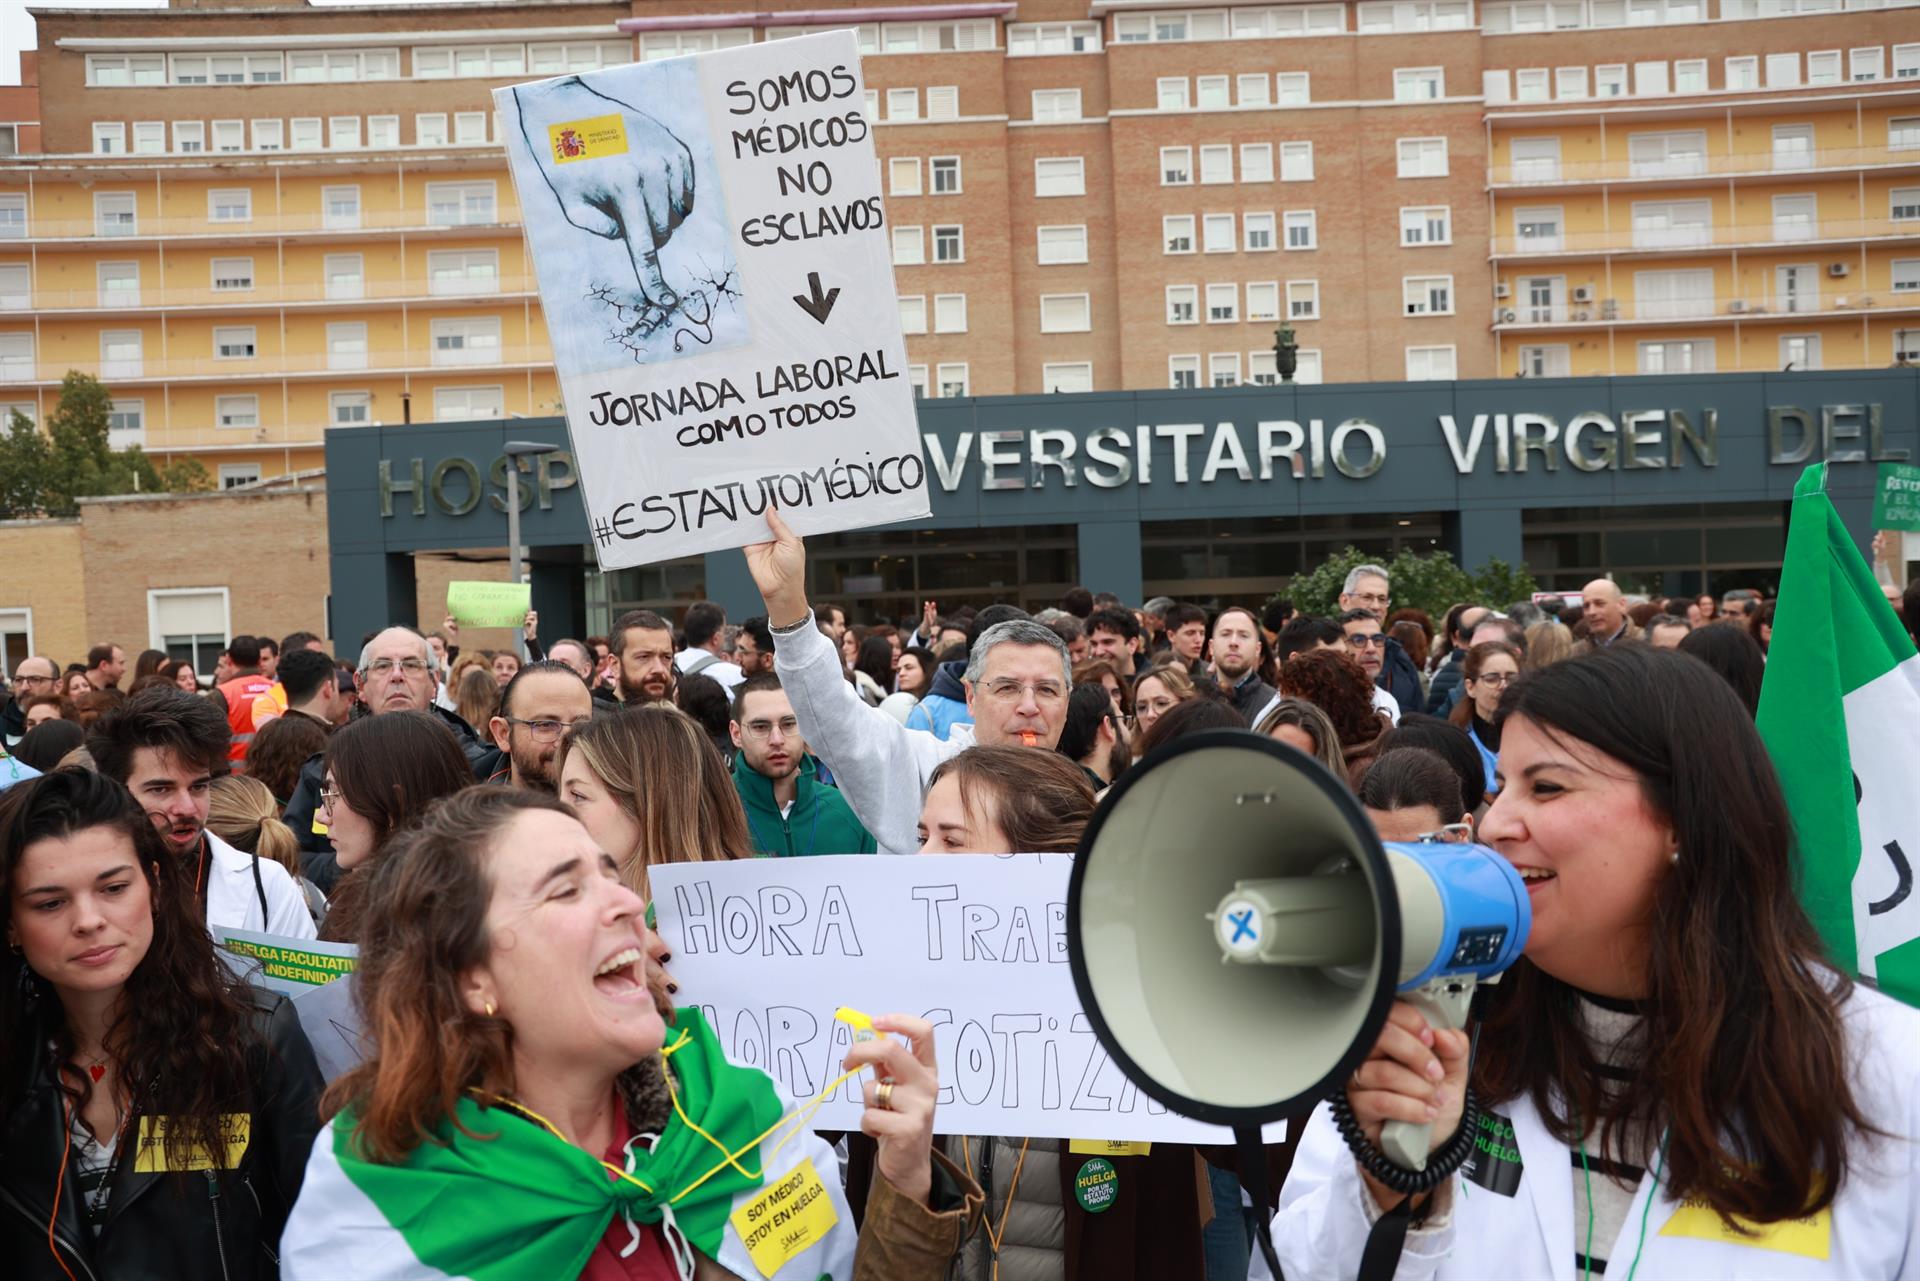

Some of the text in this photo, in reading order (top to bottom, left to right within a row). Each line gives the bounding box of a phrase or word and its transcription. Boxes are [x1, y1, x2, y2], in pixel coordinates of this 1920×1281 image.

[726, 65, 856, 115] SOMOS
[731, 111, 867, 160] MÉDICOS
[777, 161, 832, 196] NO
[741, 196, 883, 247] ESCLAVOS
[589, 350, 899, 426] JORNADA LABORAL
[676, 395, 856, 447] COMO TODOS
[378, 402, 1911, 518] HOSP VERSITARIO VIRGEN DEL
[674, 881, 1070, 964] HORA TRAB
[228, 940, 360, 972] HUELGA FACULTATIV
[265, 963, 338, 985] INDEFINIDA
[747, 1172, 805, 1223] SOY MÉDICO
[1078, 1169, 1117, 1188] HUELGA
[1084, 1186, 1114, 1201] ESTATUTO
[1088, 1182, 1110, 1194] POR UN
[1088, 1194, 1111, 1205] PROPIO
[744, 1220, 772, 1251] ESTOY
[772, 1208, 791, 1228] EN
[790, 1182, 824, 1216] HUELGA
